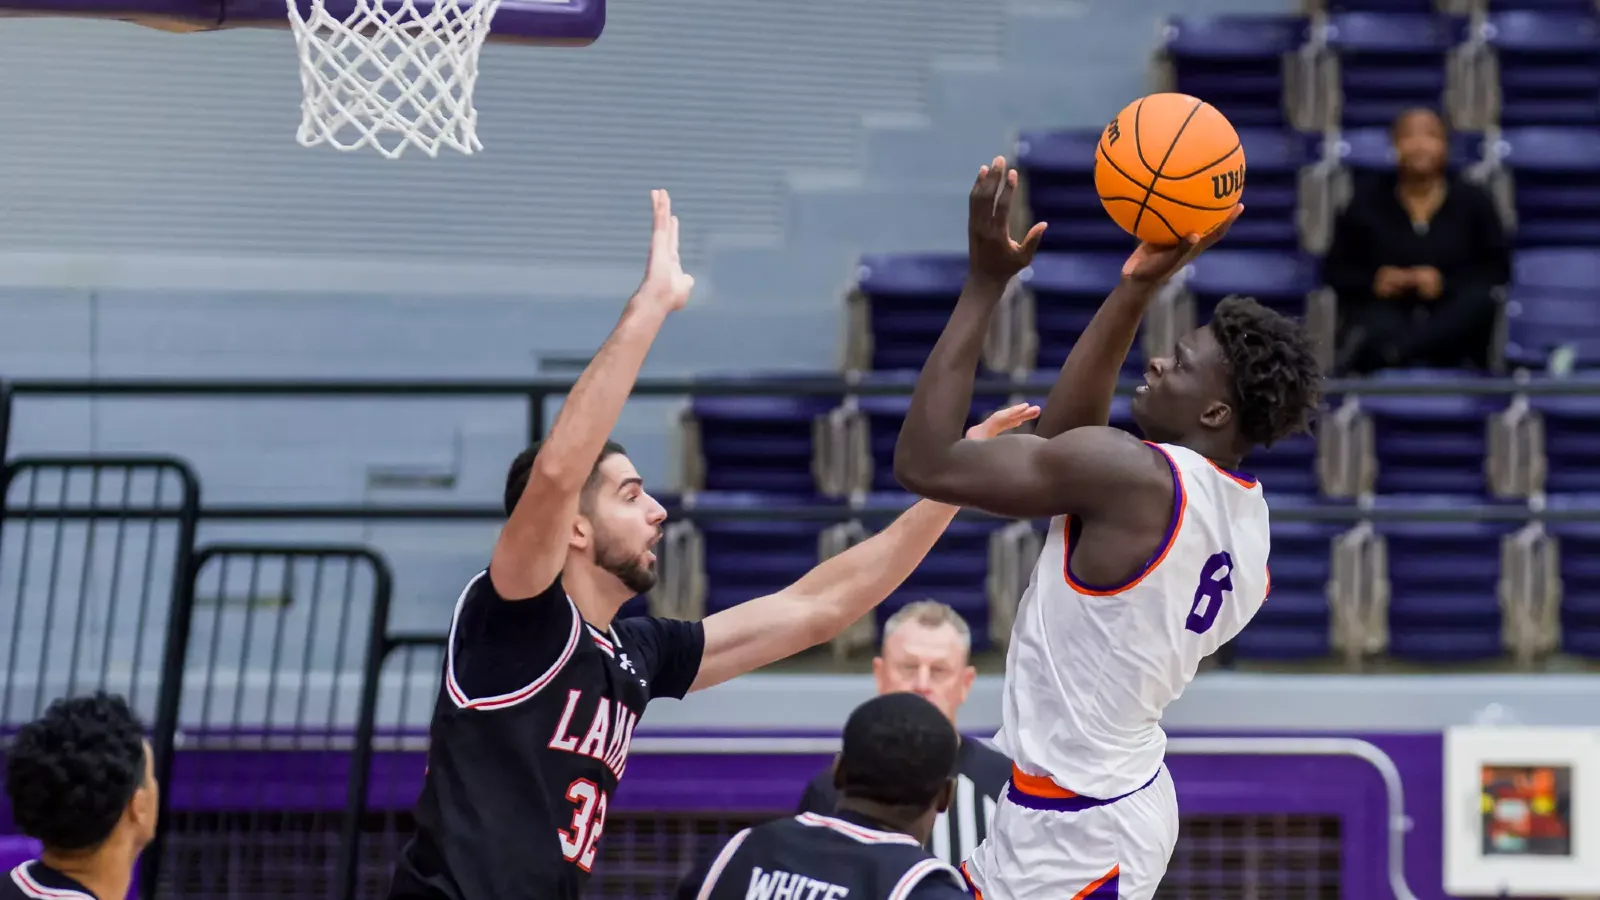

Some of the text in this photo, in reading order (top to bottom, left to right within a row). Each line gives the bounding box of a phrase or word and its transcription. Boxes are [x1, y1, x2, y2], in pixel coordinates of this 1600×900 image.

[1211, 163, 1244, 199] Wil
[1185, 550, 1233, 634] 8
[547, 688, 638, 782] LAMA
[557, 777, 607, 873] 32
